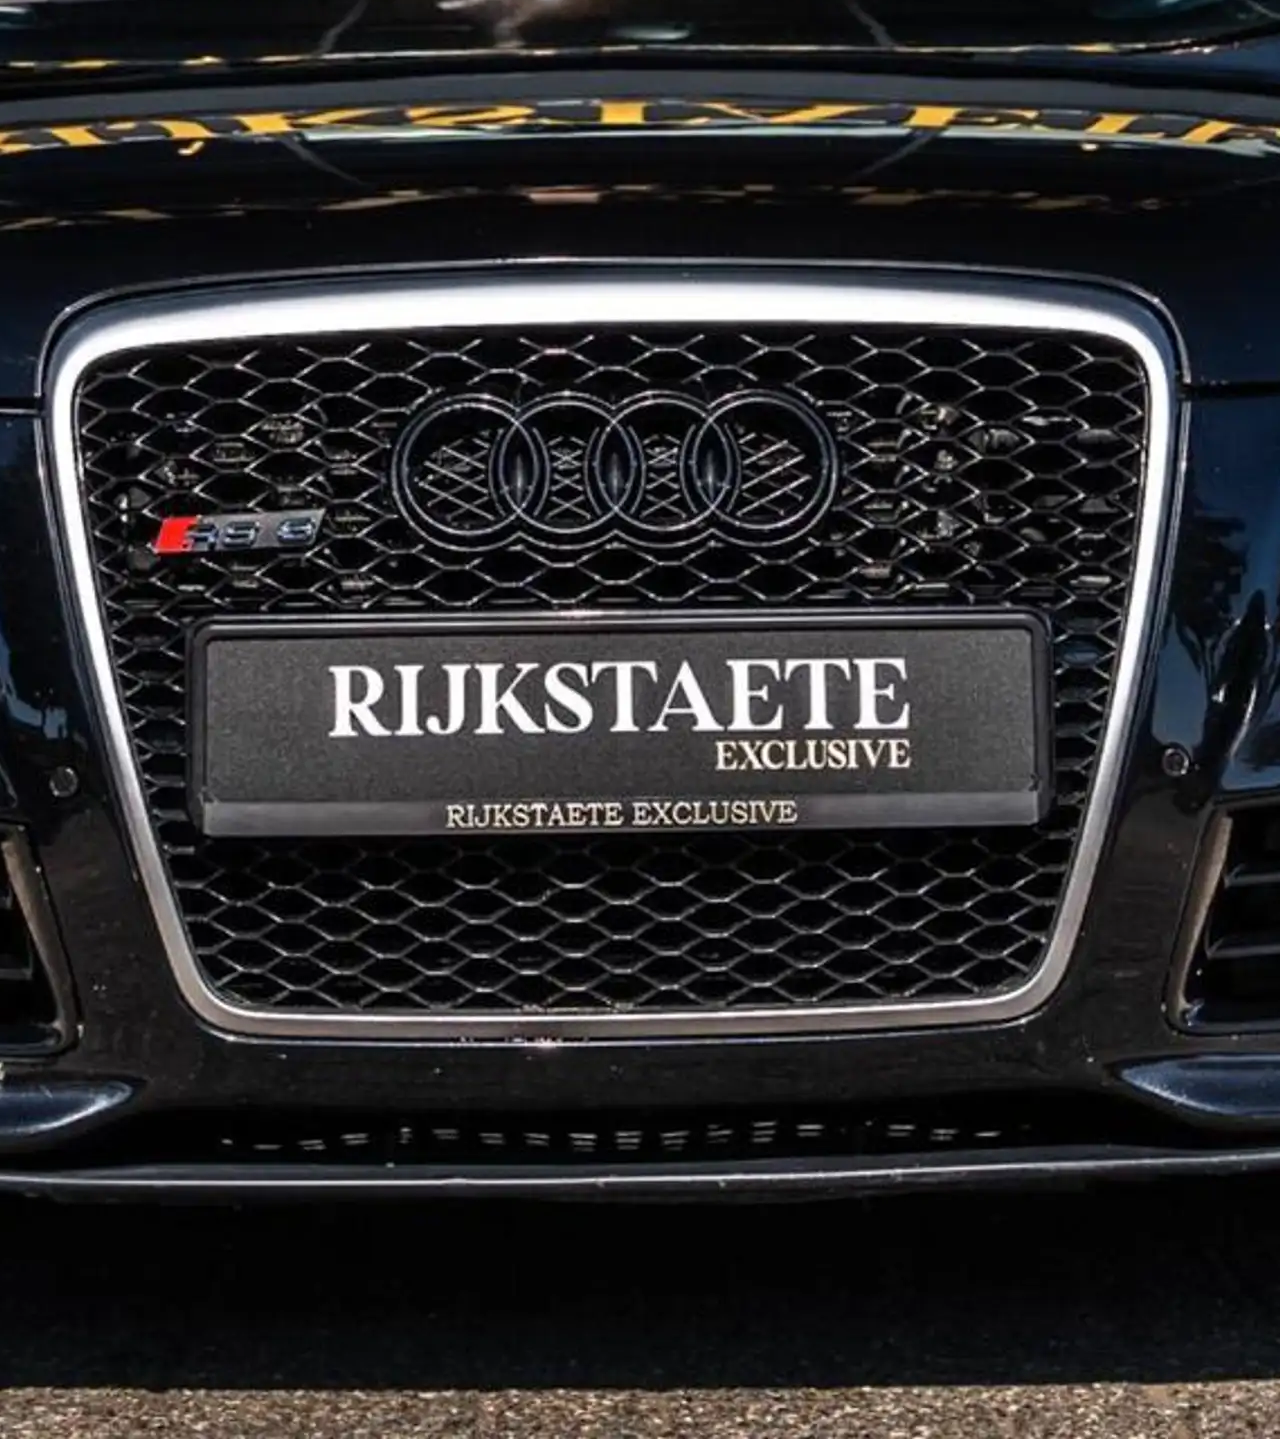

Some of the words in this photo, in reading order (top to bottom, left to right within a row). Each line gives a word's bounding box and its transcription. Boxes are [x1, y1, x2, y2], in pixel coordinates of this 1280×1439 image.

[328, 657, 912, 738] RIJKSTAETE
[715, 739, 911, 771] EXCLUSIVE
[446, 802, 623, 829] RIJKSTAETE
[632, 800, 798, 826] EXCLUSIVE
